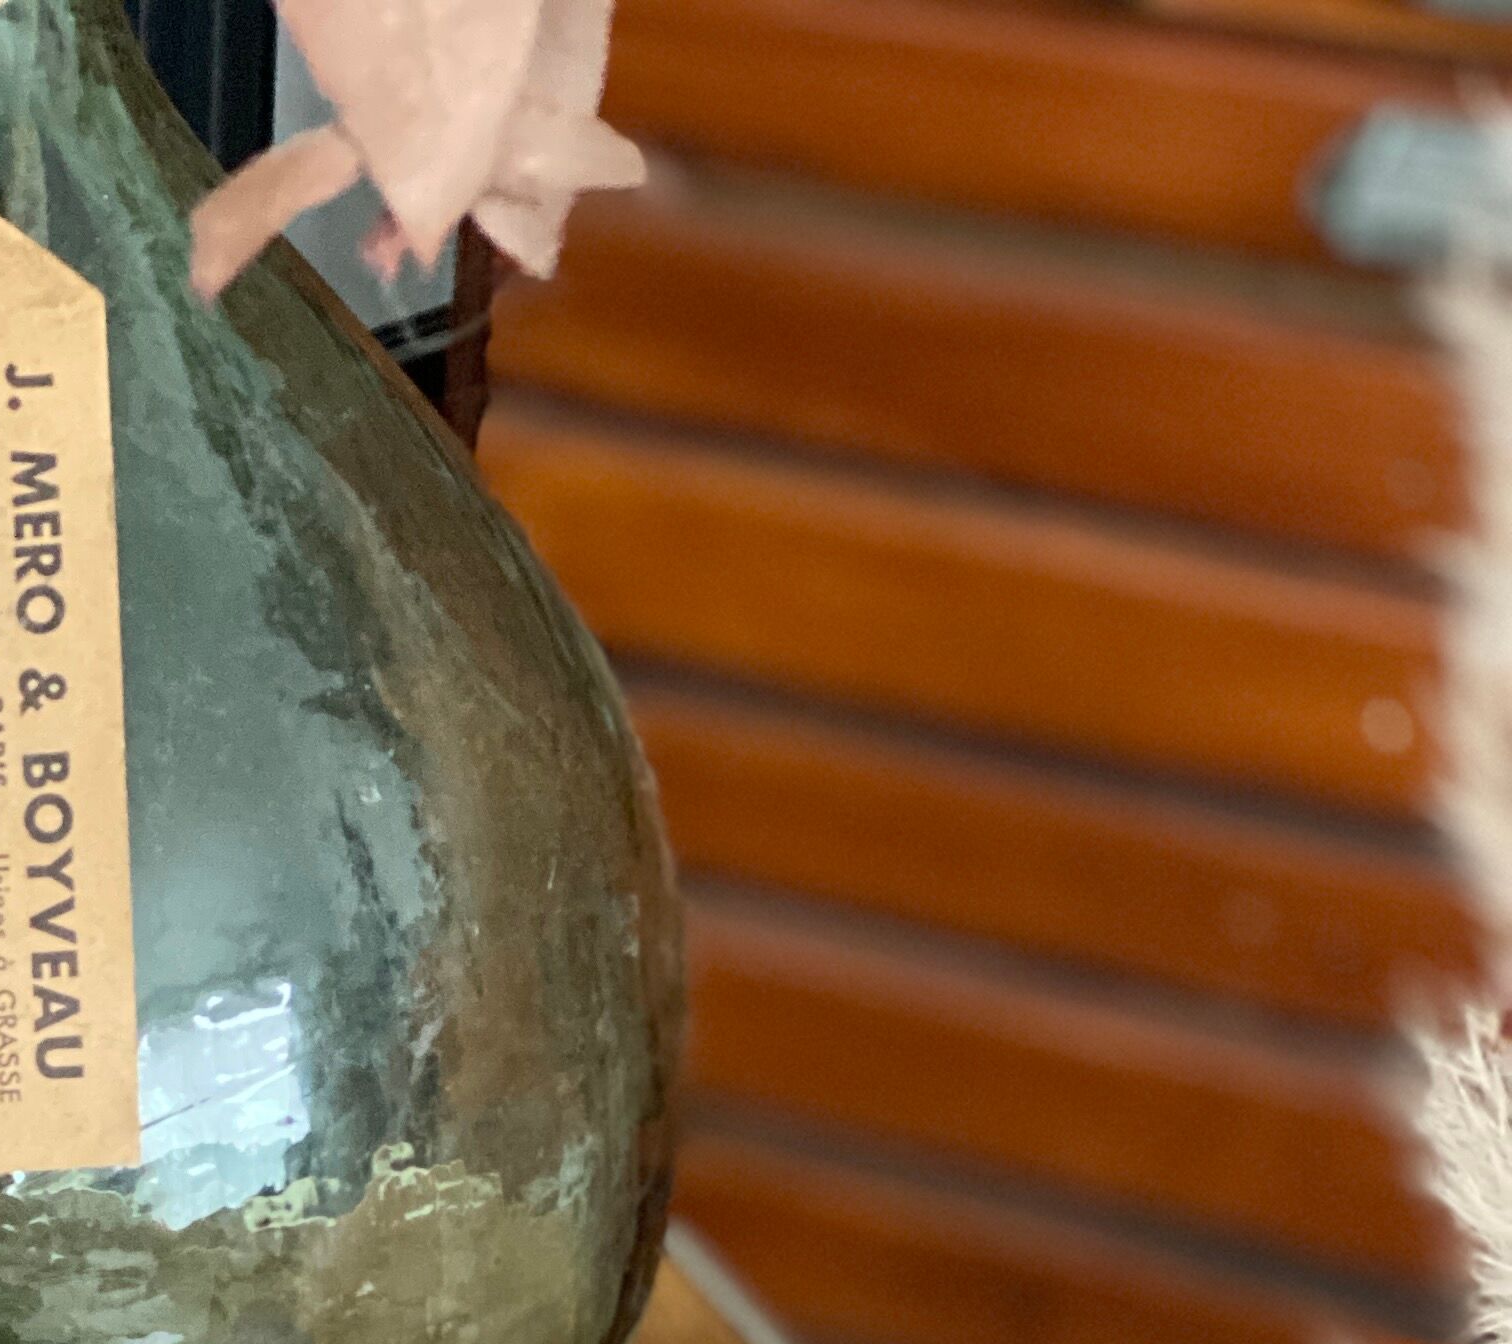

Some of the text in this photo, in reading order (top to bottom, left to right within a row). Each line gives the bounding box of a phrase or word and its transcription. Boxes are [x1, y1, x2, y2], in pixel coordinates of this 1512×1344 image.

[5, 364, 84, 1079] J. MERO & BOYVEAU
